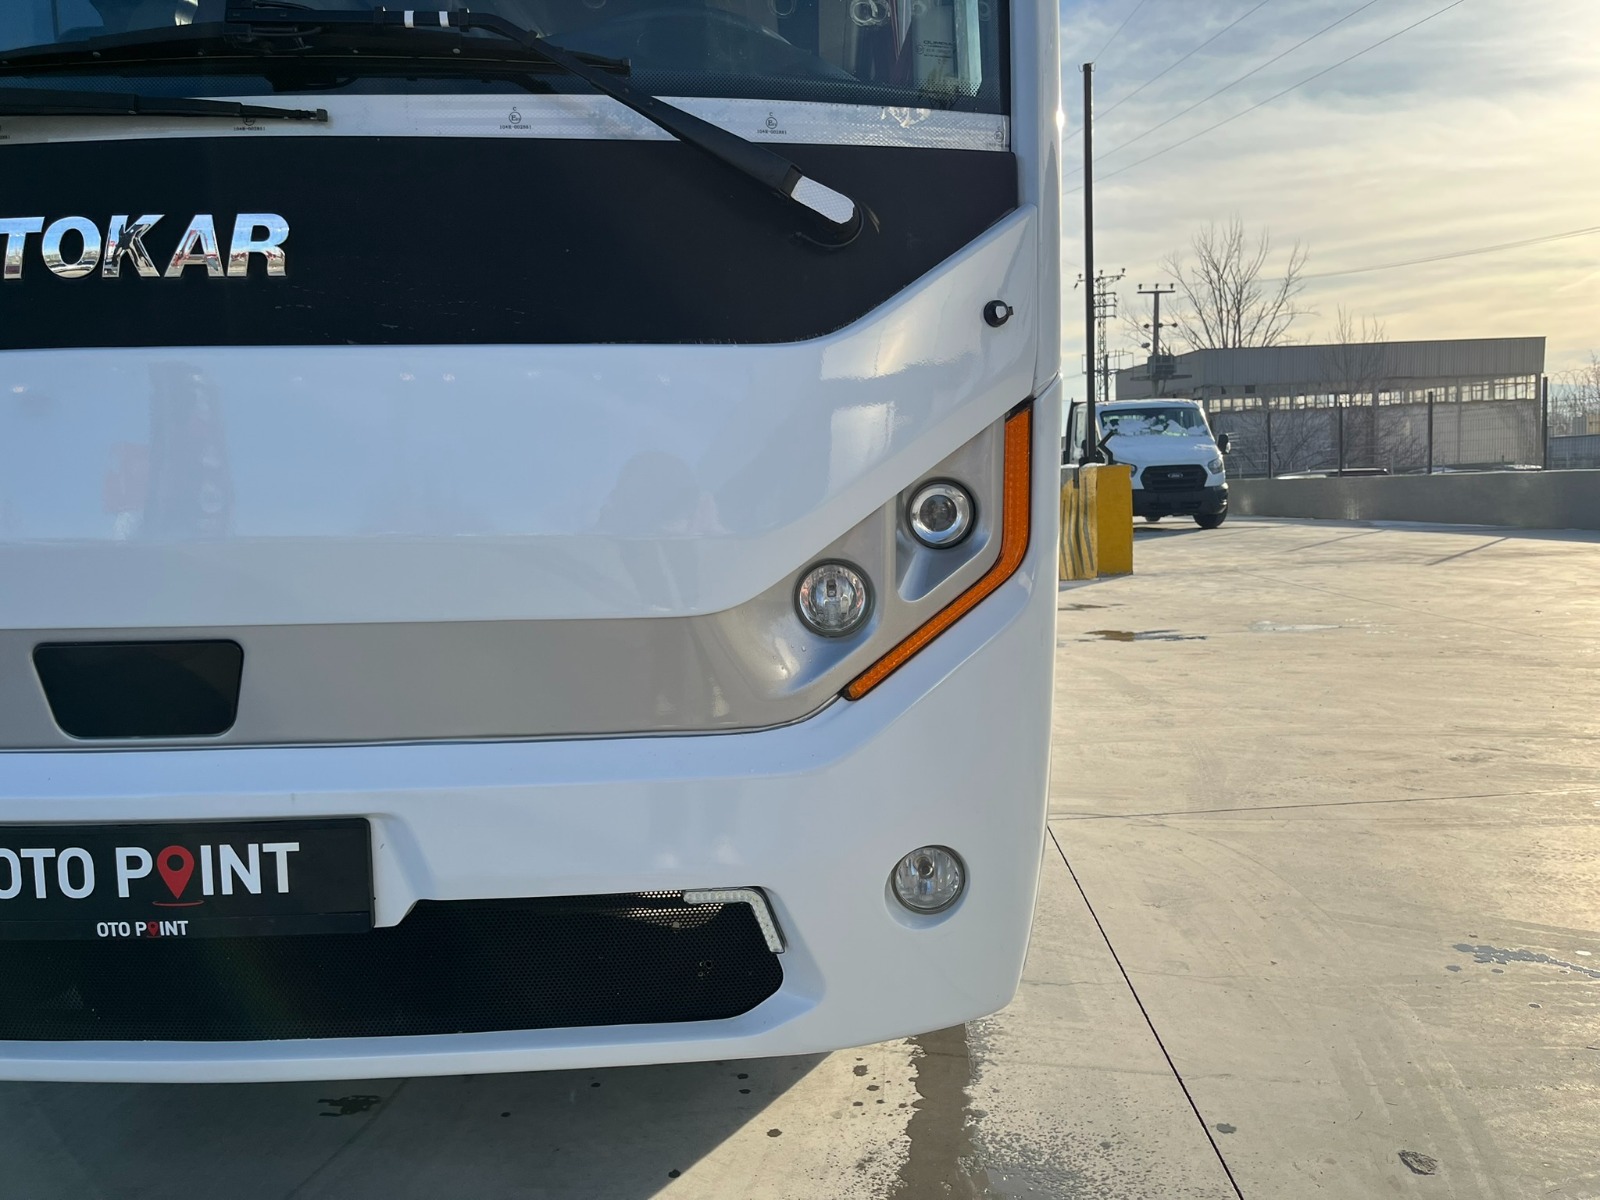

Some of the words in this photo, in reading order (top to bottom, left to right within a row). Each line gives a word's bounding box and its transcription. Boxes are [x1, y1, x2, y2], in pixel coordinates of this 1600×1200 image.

[0, 213, 290, 280] TOKAR
[0, 847, 95, 900] OTO
[115, 842, 300, 899] POINT
[96, 922, 131, 938] OTO
[135, 920, 189, 938] POINT
